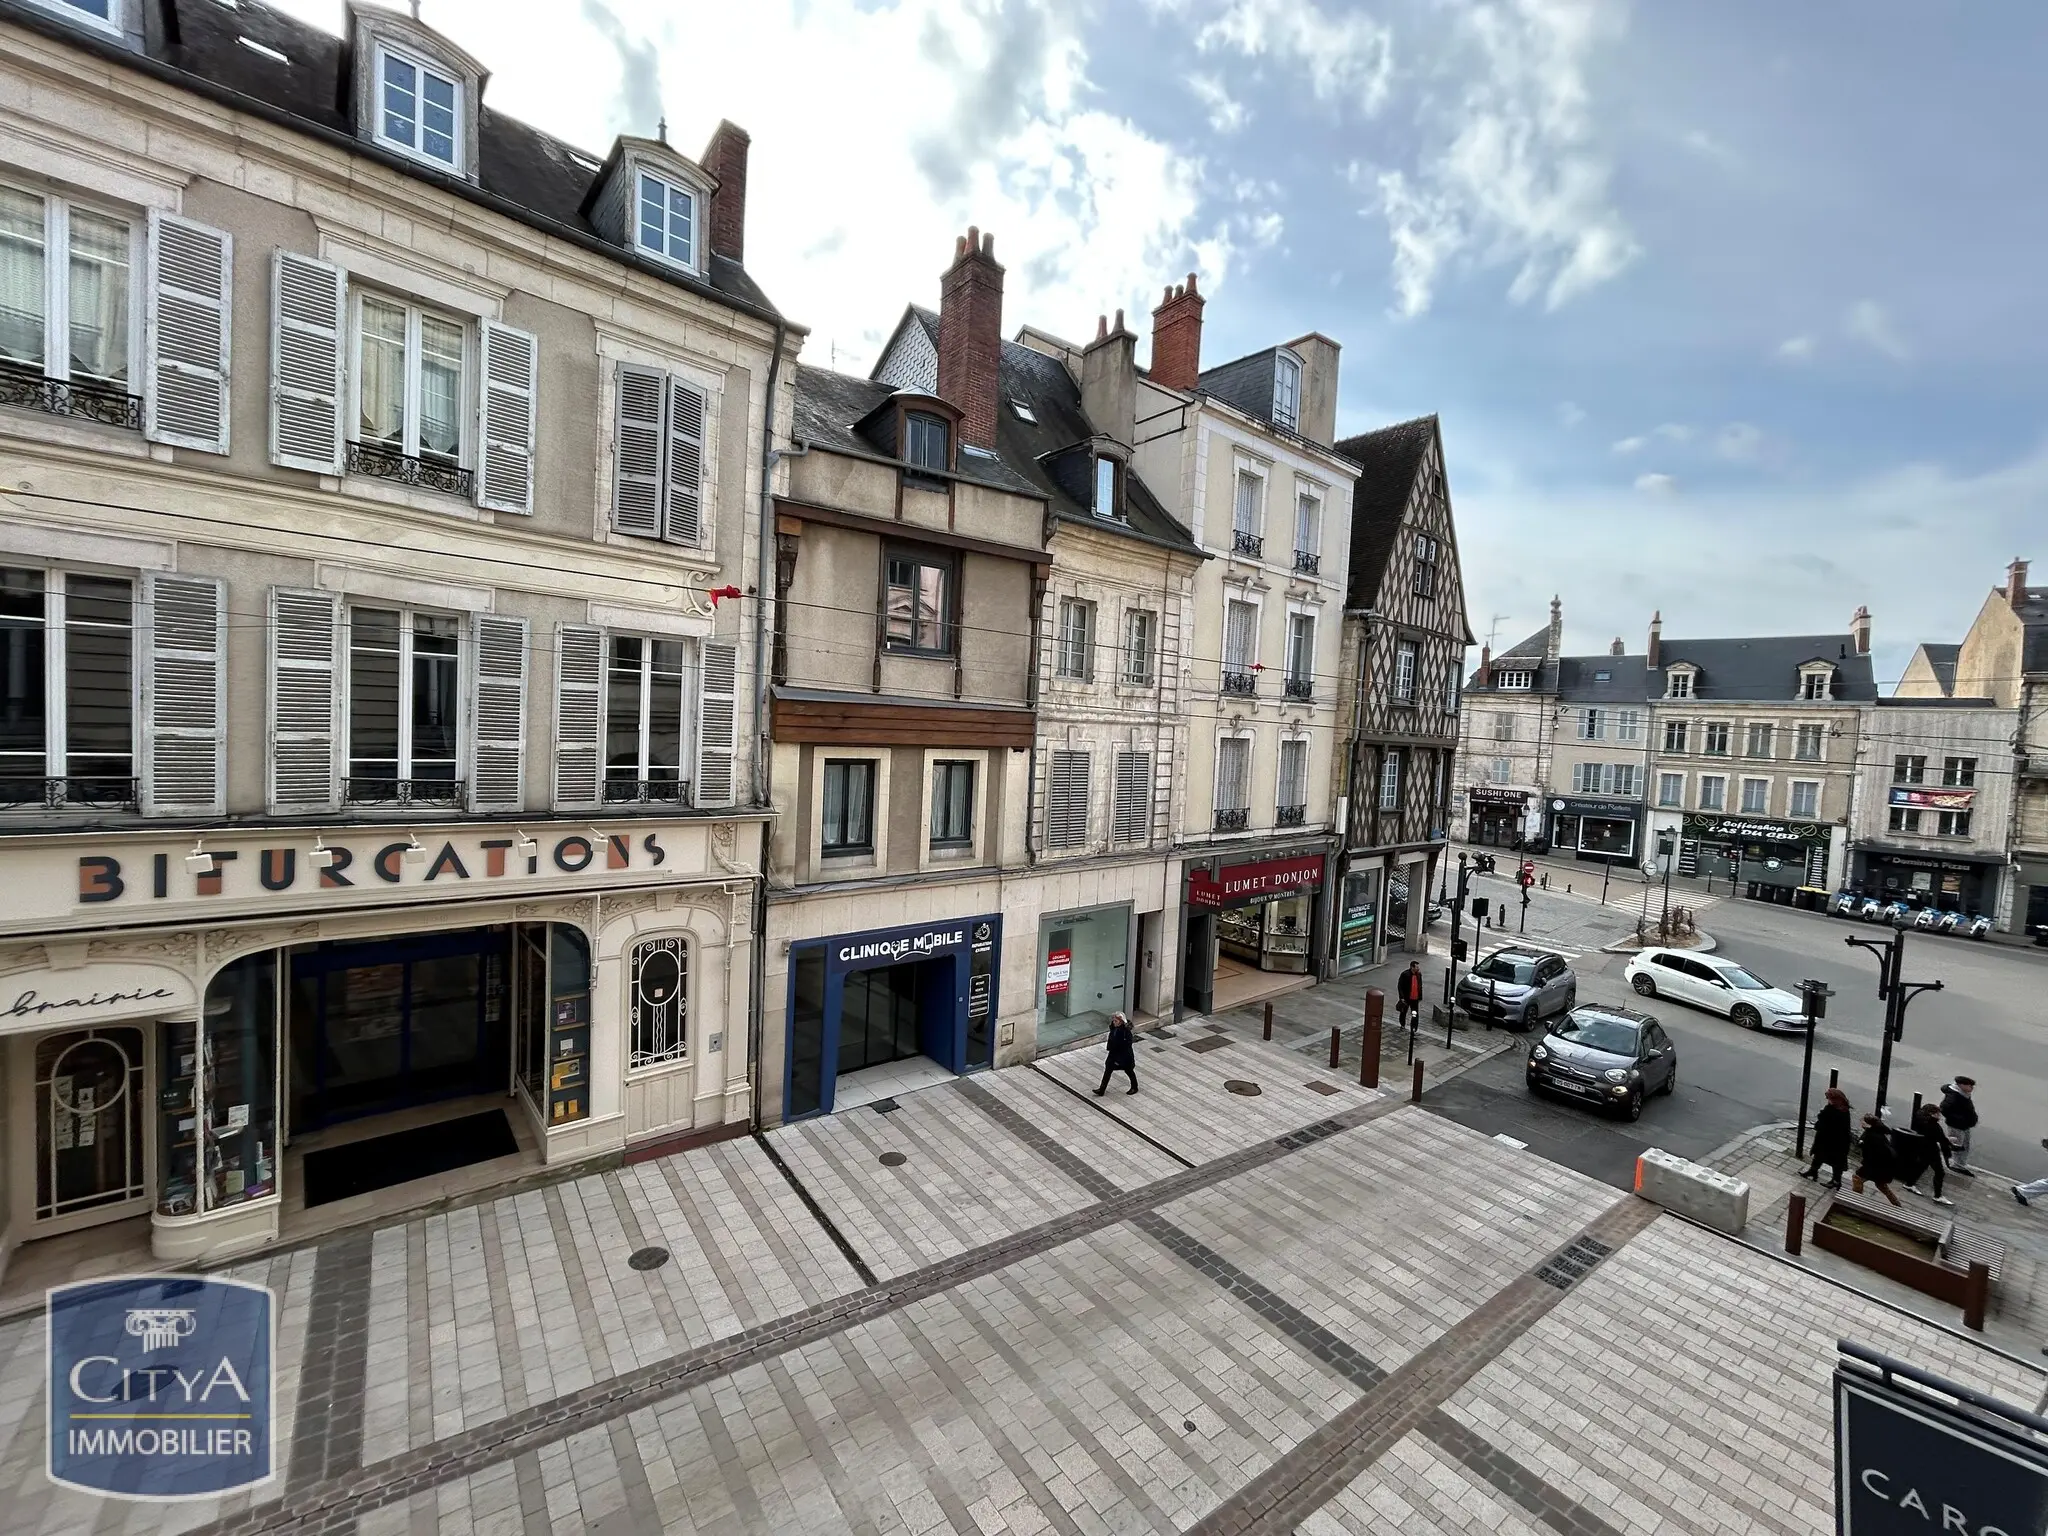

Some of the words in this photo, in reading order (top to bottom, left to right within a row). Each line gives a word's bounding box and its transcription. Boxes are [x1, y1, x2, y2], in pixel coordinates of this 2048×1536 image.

[1476, 788, 1502, 797] SUSHI
[1504, 791, 1522, 799] ONE
[1708, 826, 1737, 835] L'AS
[1740, 829, 1763, 837] DU
[1766, 832, 1800, 840] CBD
[1723, 820, 1785, 833] Coffeeshop
[1892, 857, 1939, 868] Domino's
[1941, 861, 1970, 871] Pizza
[1225, 876, 1267, 894] LUMET
[1275, 868, 1318, 886] DONJON
[1196, 890, 1221, 900] LUMET
[1196, 896, 1221, 906] DONJON
[1250, 895, 1268, 905] BIJOUX
[1273, 890, 1295, 900] MONTRES
[1348, 903, 1371, 914] PHARMACIE
[839, 939, 910, 961] CLINIQUE
[913, 931, 963, 953] MOBILE
